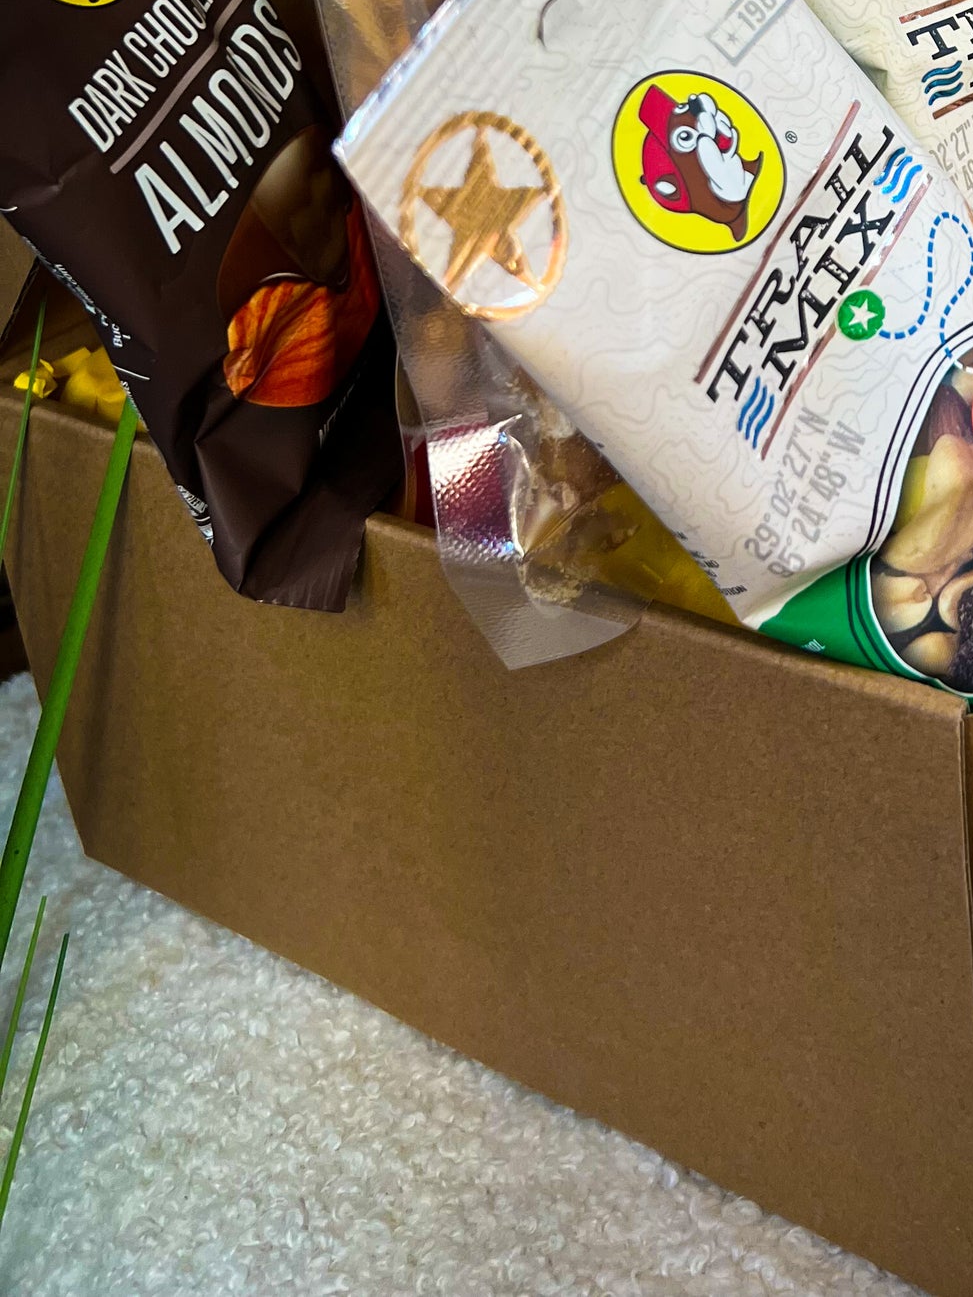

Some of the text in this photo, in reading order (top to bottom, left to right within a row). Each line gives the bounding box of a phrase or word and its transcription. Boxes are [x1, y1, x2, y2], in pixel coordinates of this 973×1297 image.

[68, 49, 157, 153] DARK
[706, 124, 895, 404] TRAIL
[760, 189, 897, 392] MIX
